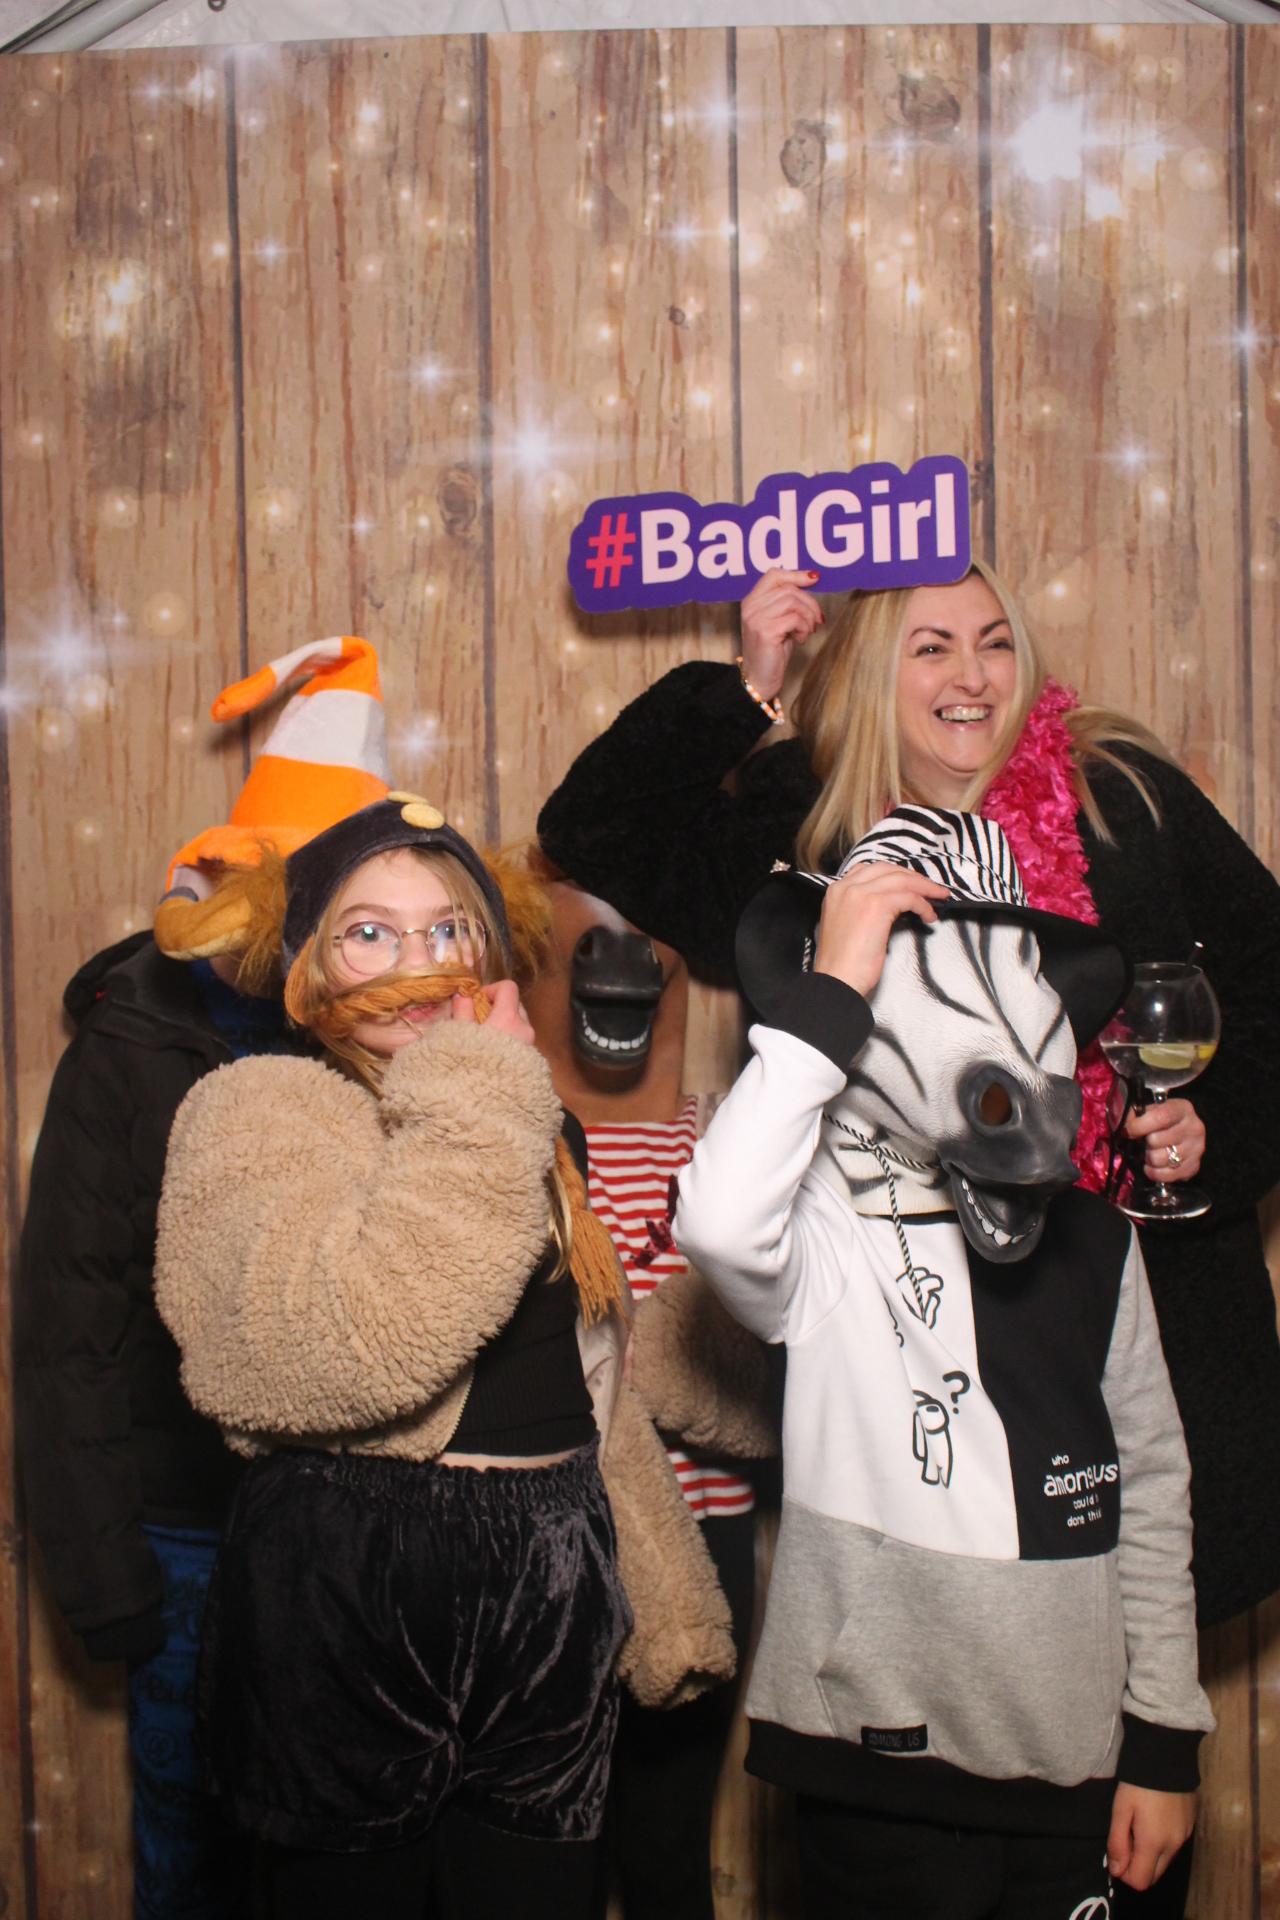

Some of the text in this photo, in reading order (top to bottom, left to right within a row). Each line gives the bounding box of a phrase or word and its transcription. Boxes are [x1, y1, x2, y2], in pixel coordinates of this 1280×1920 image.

[585, 473, 957, 589] #BadGirl
[1051, 1453, 1070, 1467] who
[1067, 1514, 1086, 1528] done
